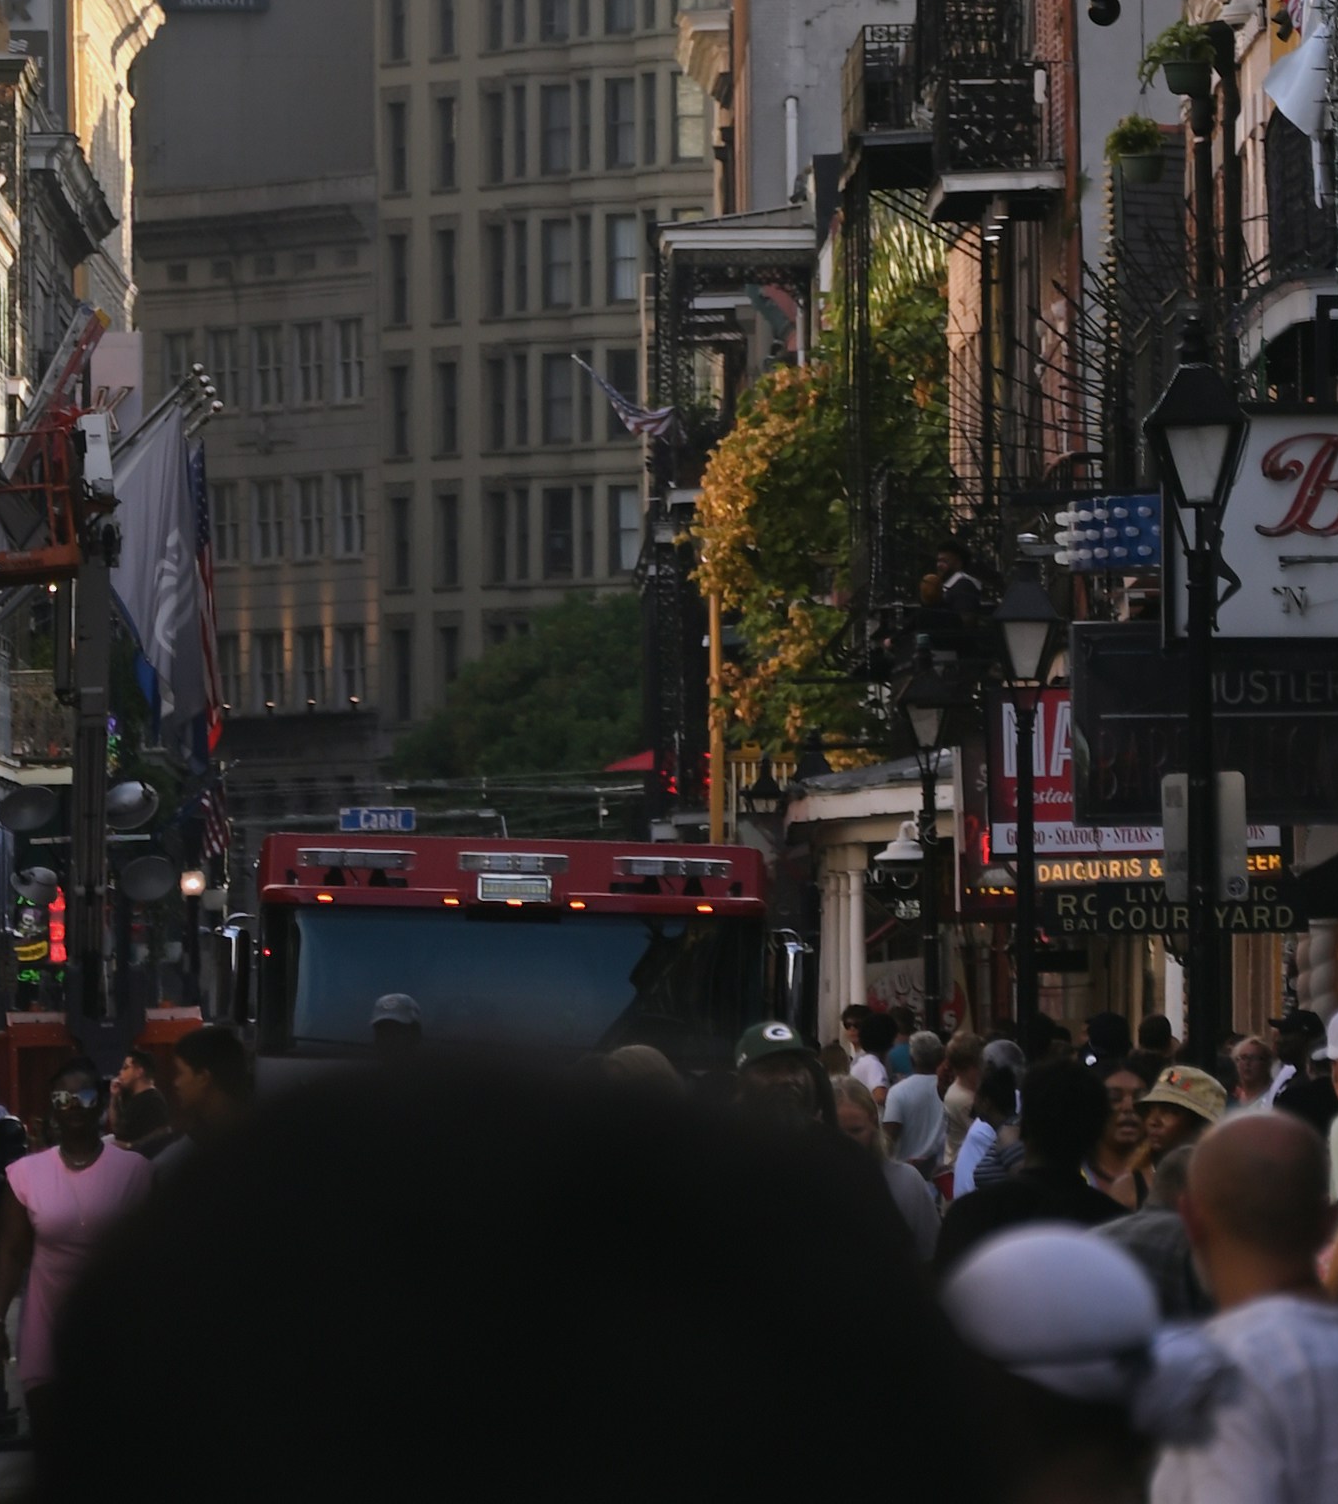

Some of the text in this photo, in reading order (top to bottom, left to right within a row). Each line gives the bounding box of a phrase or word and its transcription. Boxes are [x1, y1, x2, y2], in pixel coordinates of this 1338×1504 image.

[360, 808, 404, 830] Canal
[1113, 826, 1153, 843] STEAKS
[1037, 857, 1143, 883] DAIQUIRIS
